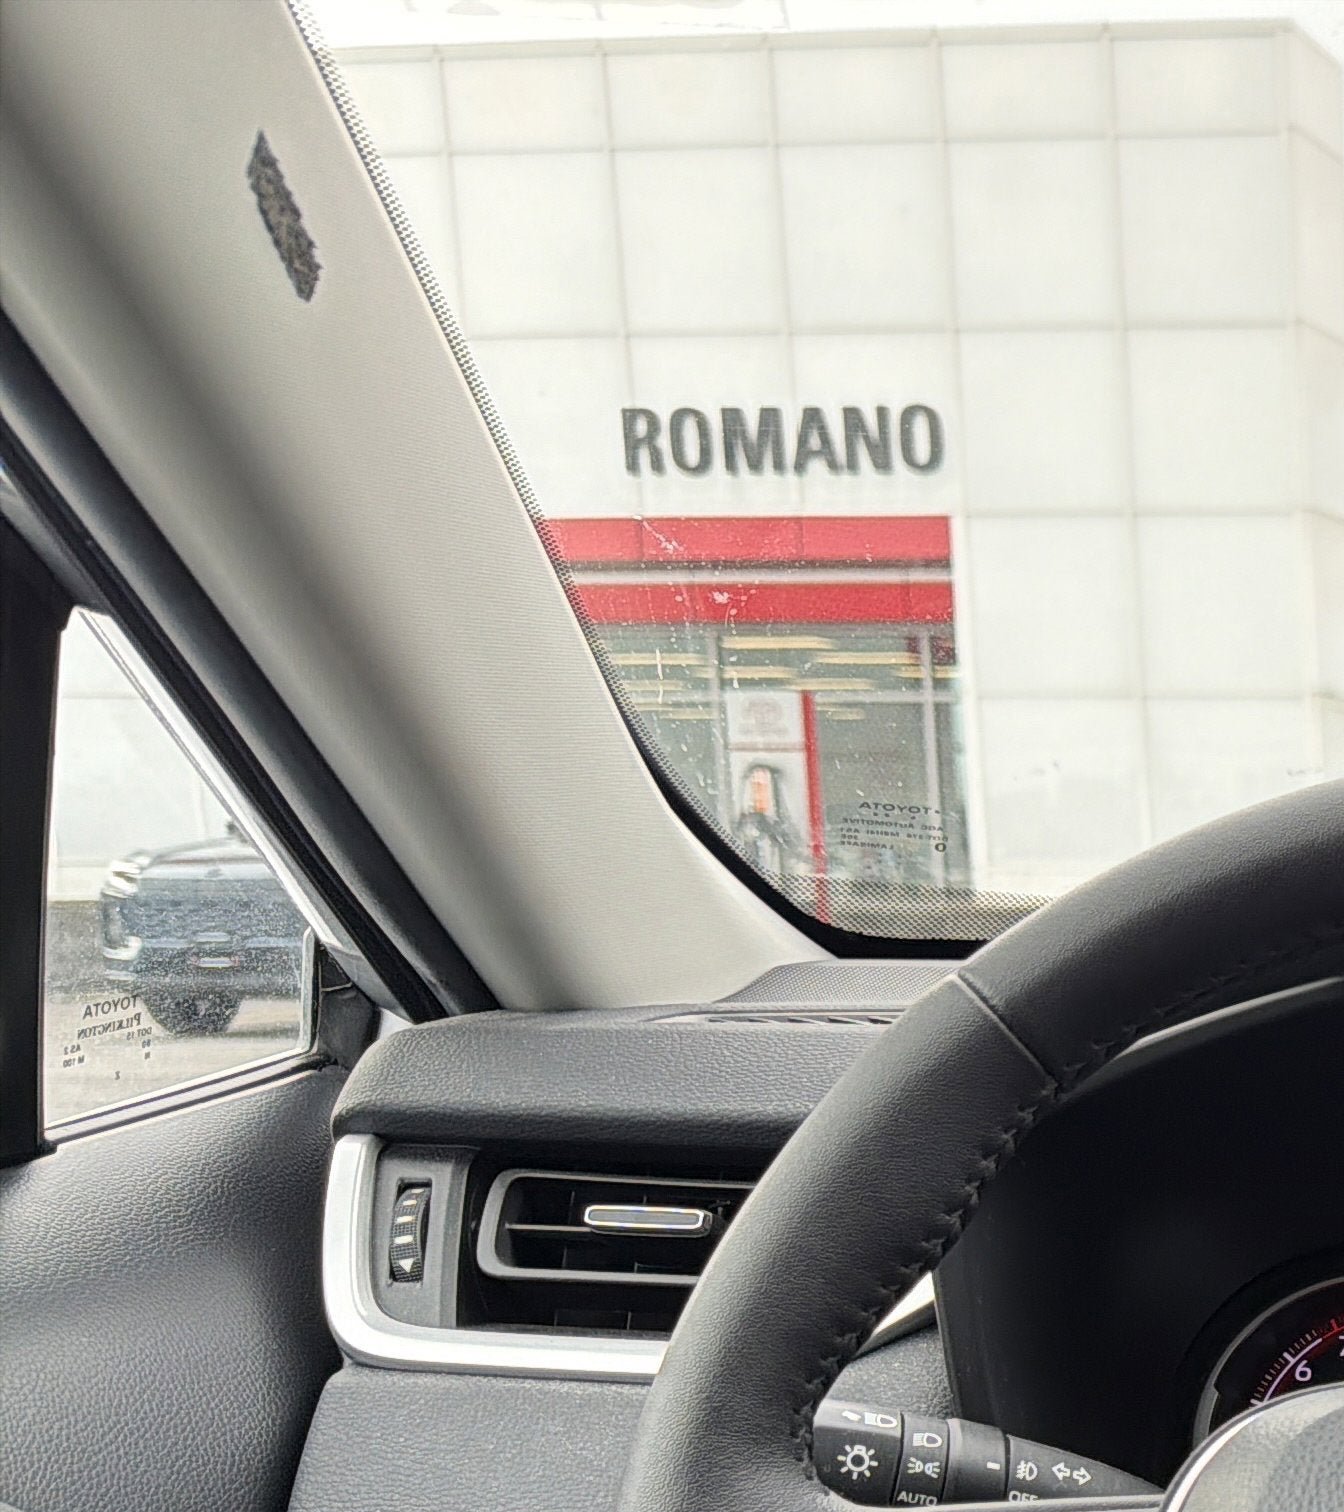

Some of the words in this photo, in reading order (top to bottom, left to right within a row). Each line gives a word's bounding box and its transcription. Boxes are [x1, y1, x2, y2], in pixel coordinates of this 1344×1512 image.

[621, 403, 947, 477] ROMANO
[1294, 1360, 1312, 1382] 6
[896, 1491, 938, 1507] AUTO
